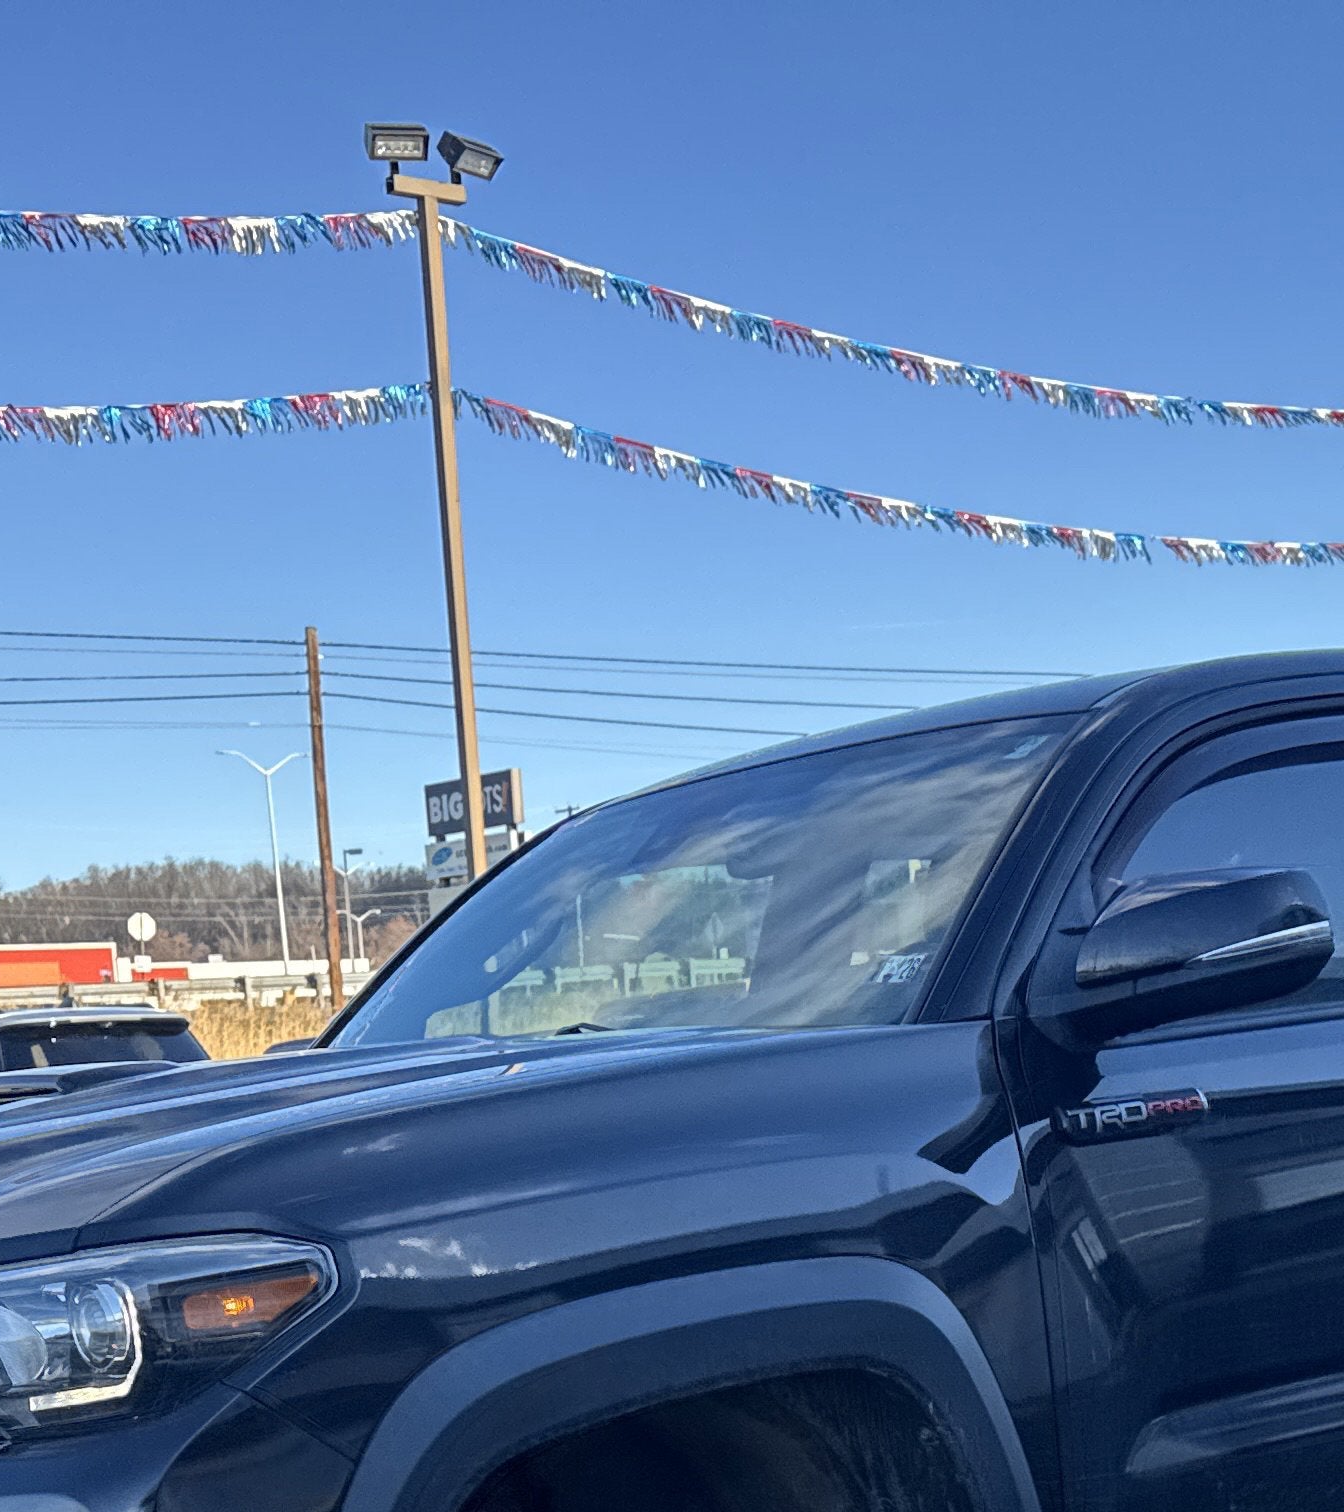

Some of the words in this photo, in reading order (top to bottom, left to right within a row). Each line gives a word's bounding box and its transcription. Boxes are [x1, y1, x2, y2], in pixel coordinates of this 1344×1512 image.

[429, 792, 464, 824] BIG
[482, 782, 509, 815] TS!
[1066, 1101, 1147, 1132] TRD
[1147, 1096, 1203, 1116] PRO
